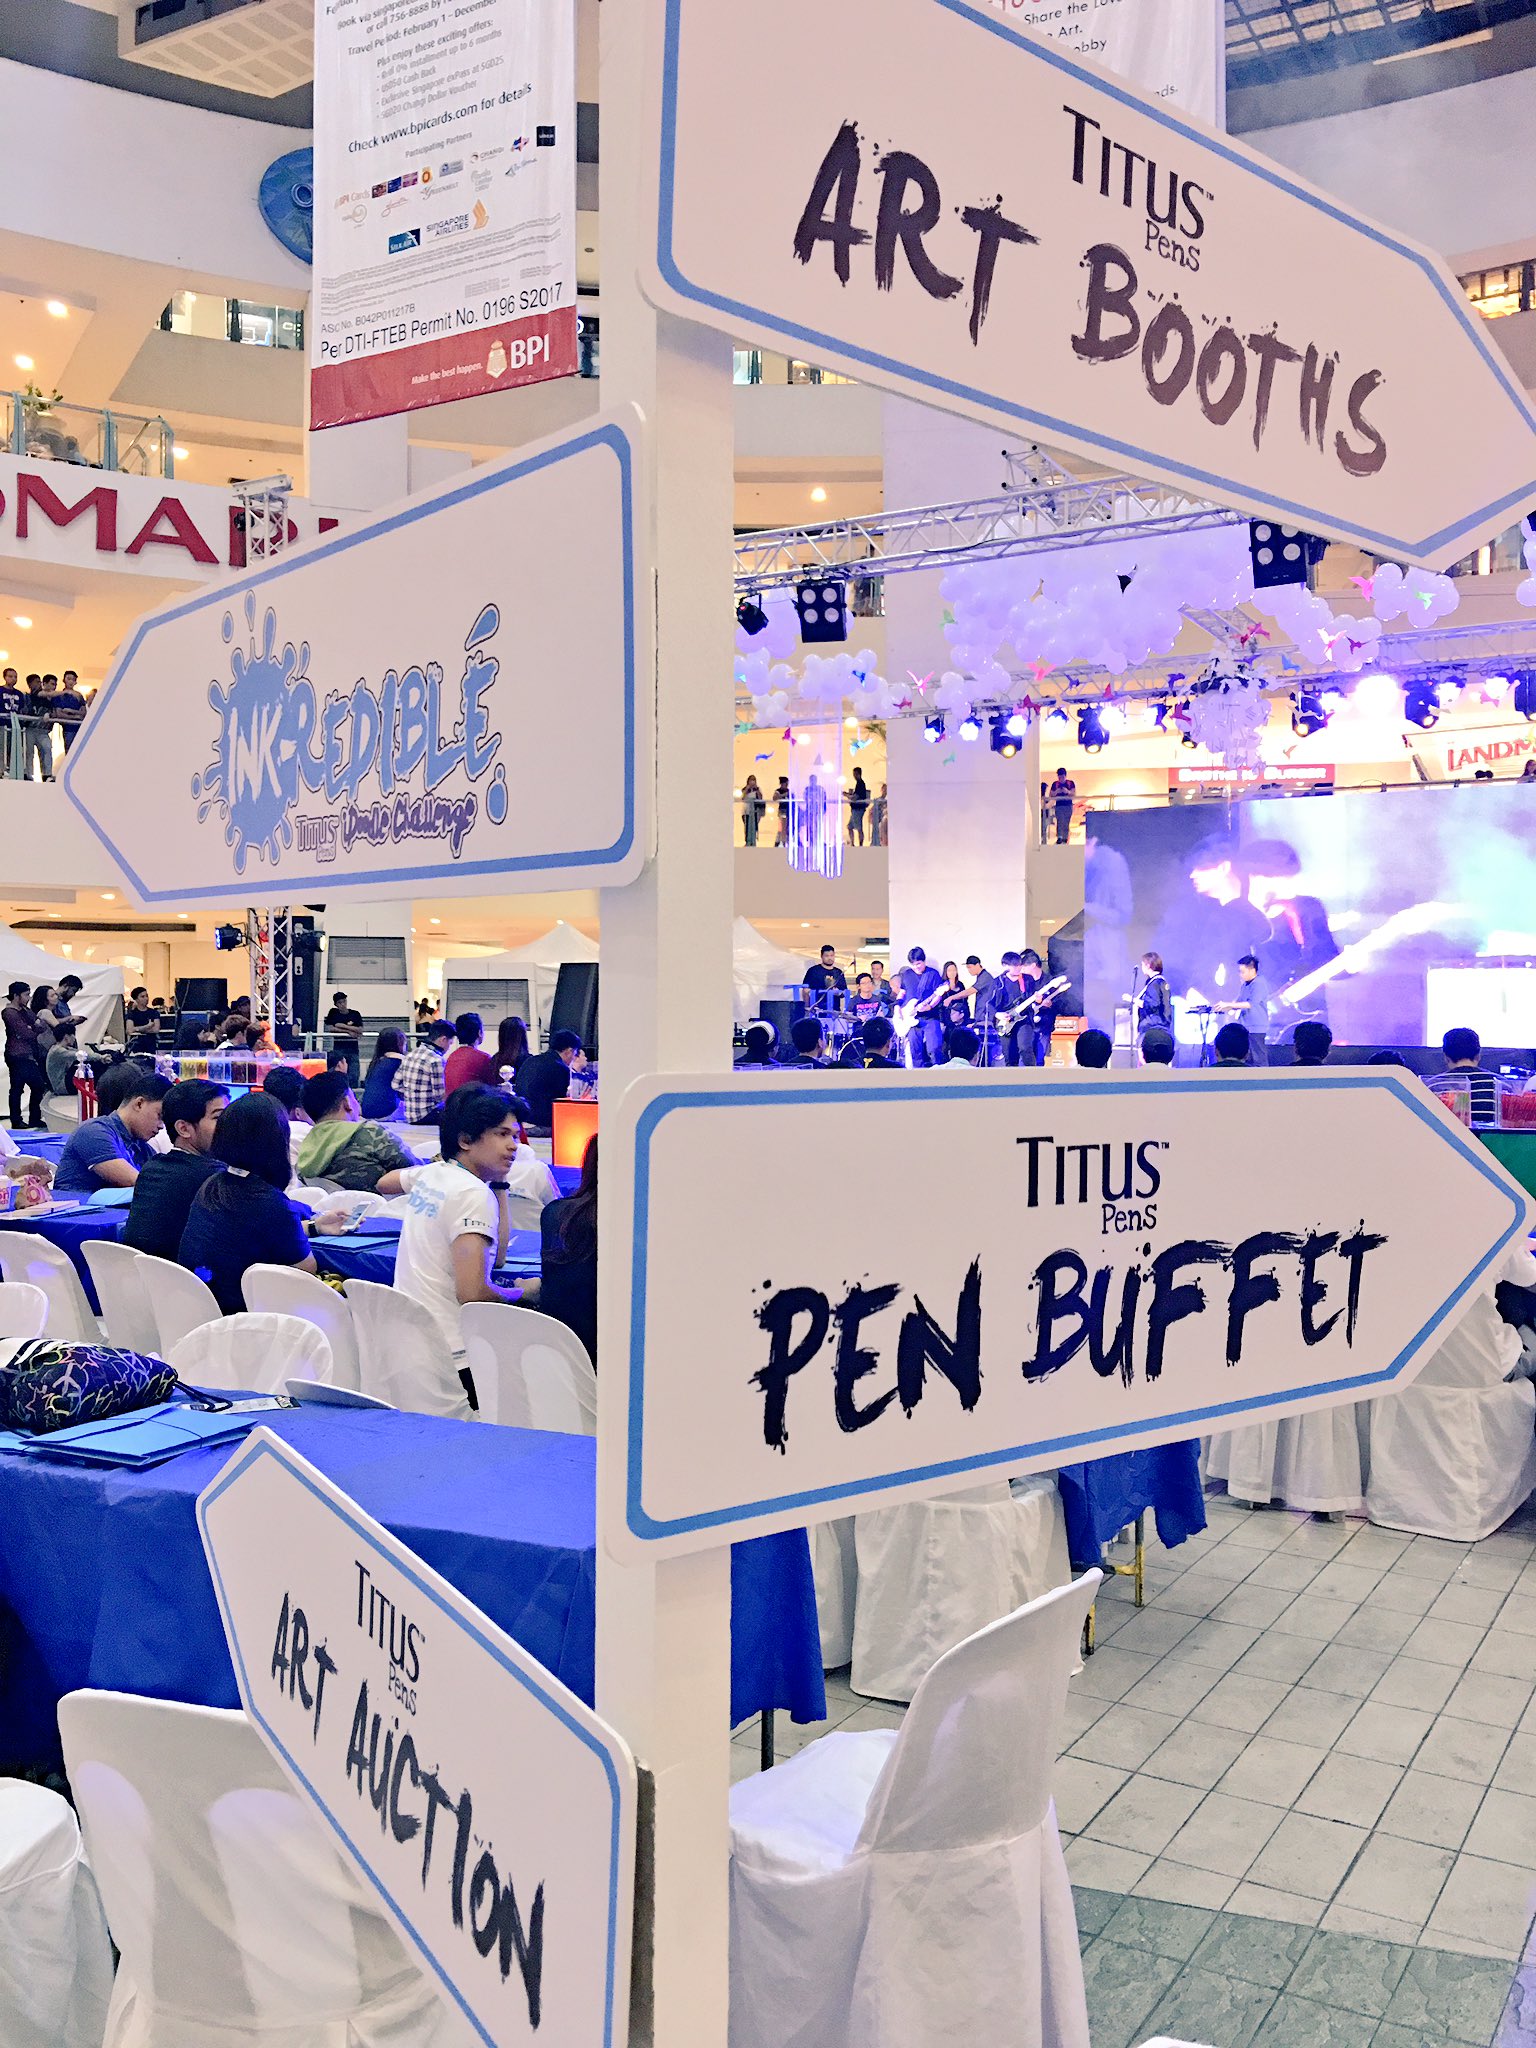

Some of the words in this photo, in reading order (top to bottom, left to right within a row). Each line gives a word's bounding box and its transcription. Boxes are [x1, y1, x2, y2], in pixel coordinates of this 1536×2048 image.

[359, 13, 371, 23] via
[366, 25, 374, 34] or
[376, 16, 388, 30] call
[389, 2, 430, 23] 756-8888
[1024, 10, 1062, 25] Share
[1067, 1, 1088, 15] the
[348, 41, 373, 55] Travel
[403, 18, 439, 36] February
[392, 48, 413, 61] enjoy
[415, 40, 435, 53] these
[437, 28, 467, 45] exciting
[468, 19, 494, 34] offers:
[1058, 24, 1083, 38] Art.
[348, 136, 379, 153] Check
[381, 104, 478, 144] www.bpicards.com
[481, 98, 496, 111] for
[405, 140, 445, 158] Participating
[446, 132, 473, 145] Partners
[426, 213, 470, 232] SINGAPORE
[435, 222, 470, 237] AIRLINES
[793, 119, 1040, 346] ART
[1145, 219, 1200, 272] Pens
[321, 341, 342, 359] Per
[345, 323, 406, 354] DTI-FTEB
[411, 311, 452, 338] Permit
[456, 307, 478, 327] No.
[483, 295, 515, 320] 0196
[519, 282, 563, 310] S2017
[321, 323, 341, 334] ASC
[510, 333, 550, 369] BPI
[411, 373, 429, 385] Make
[430, 370, 441, 380] the
[441, 366, 456, 378] best
[1101, 1203, 1158, 1235] Pens
[748, 1253, 984, 1455] PEN
[388, 1661, 417, 1716] Pens
[271, 1590, 338, 1746] ART
[346, 1677, 545, 2032] AUCTION
